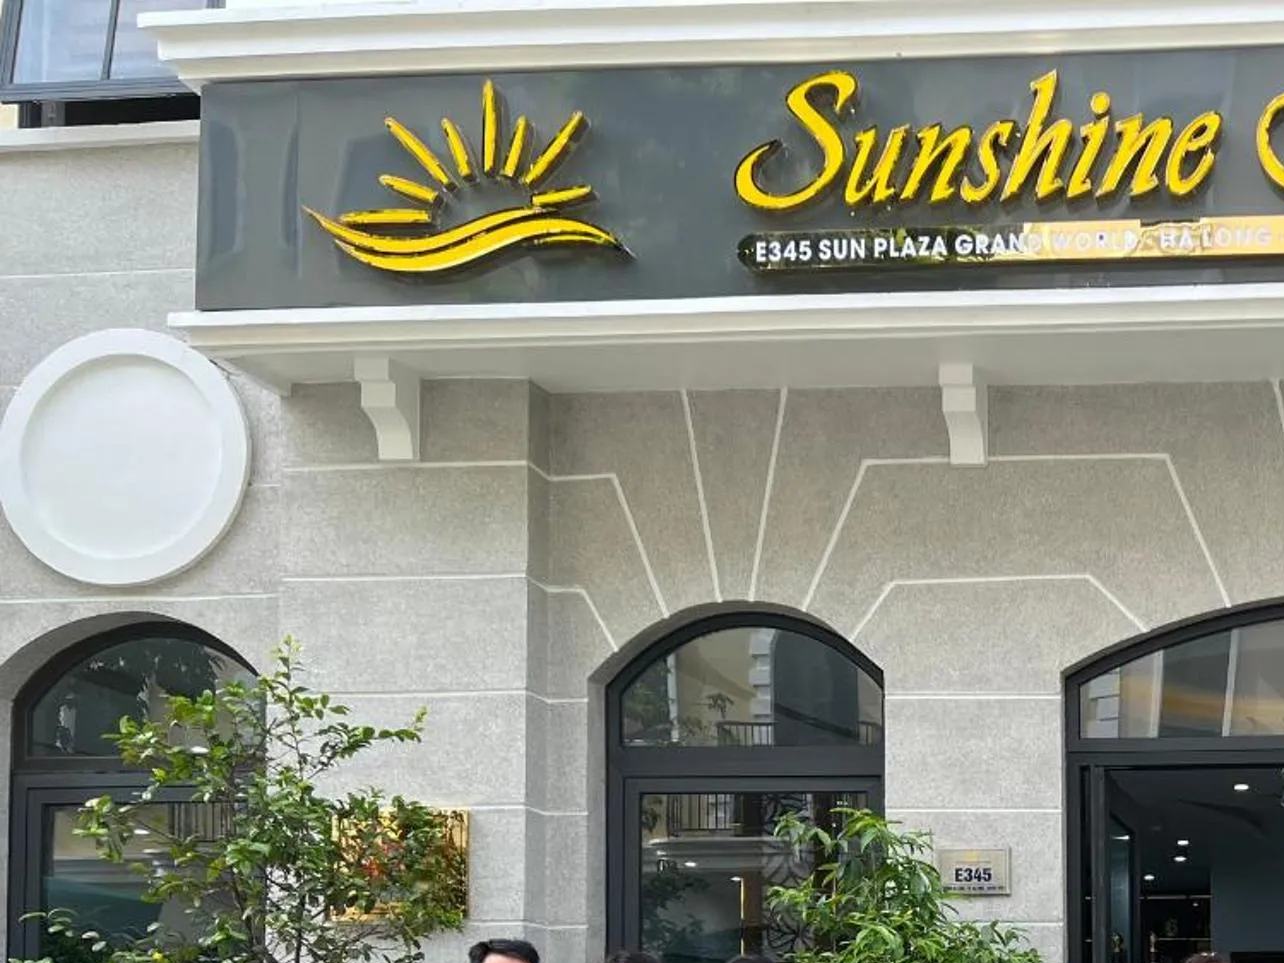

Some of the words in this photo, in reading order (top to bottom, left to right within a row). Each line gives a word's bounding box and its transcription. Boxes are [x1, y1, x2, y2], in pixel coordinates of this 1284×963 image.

[734, 69, 1222, 209] Sunshine
[756, 240, 812, 262] E345
[819, 238, 865, 260] SUN
[874, 235, 948, 258] PLAZA
[955, 232, 1042, 255] GRAND
[1053, 230, 1137, 251] WORLD
[955, 867, 992, 882] E345
